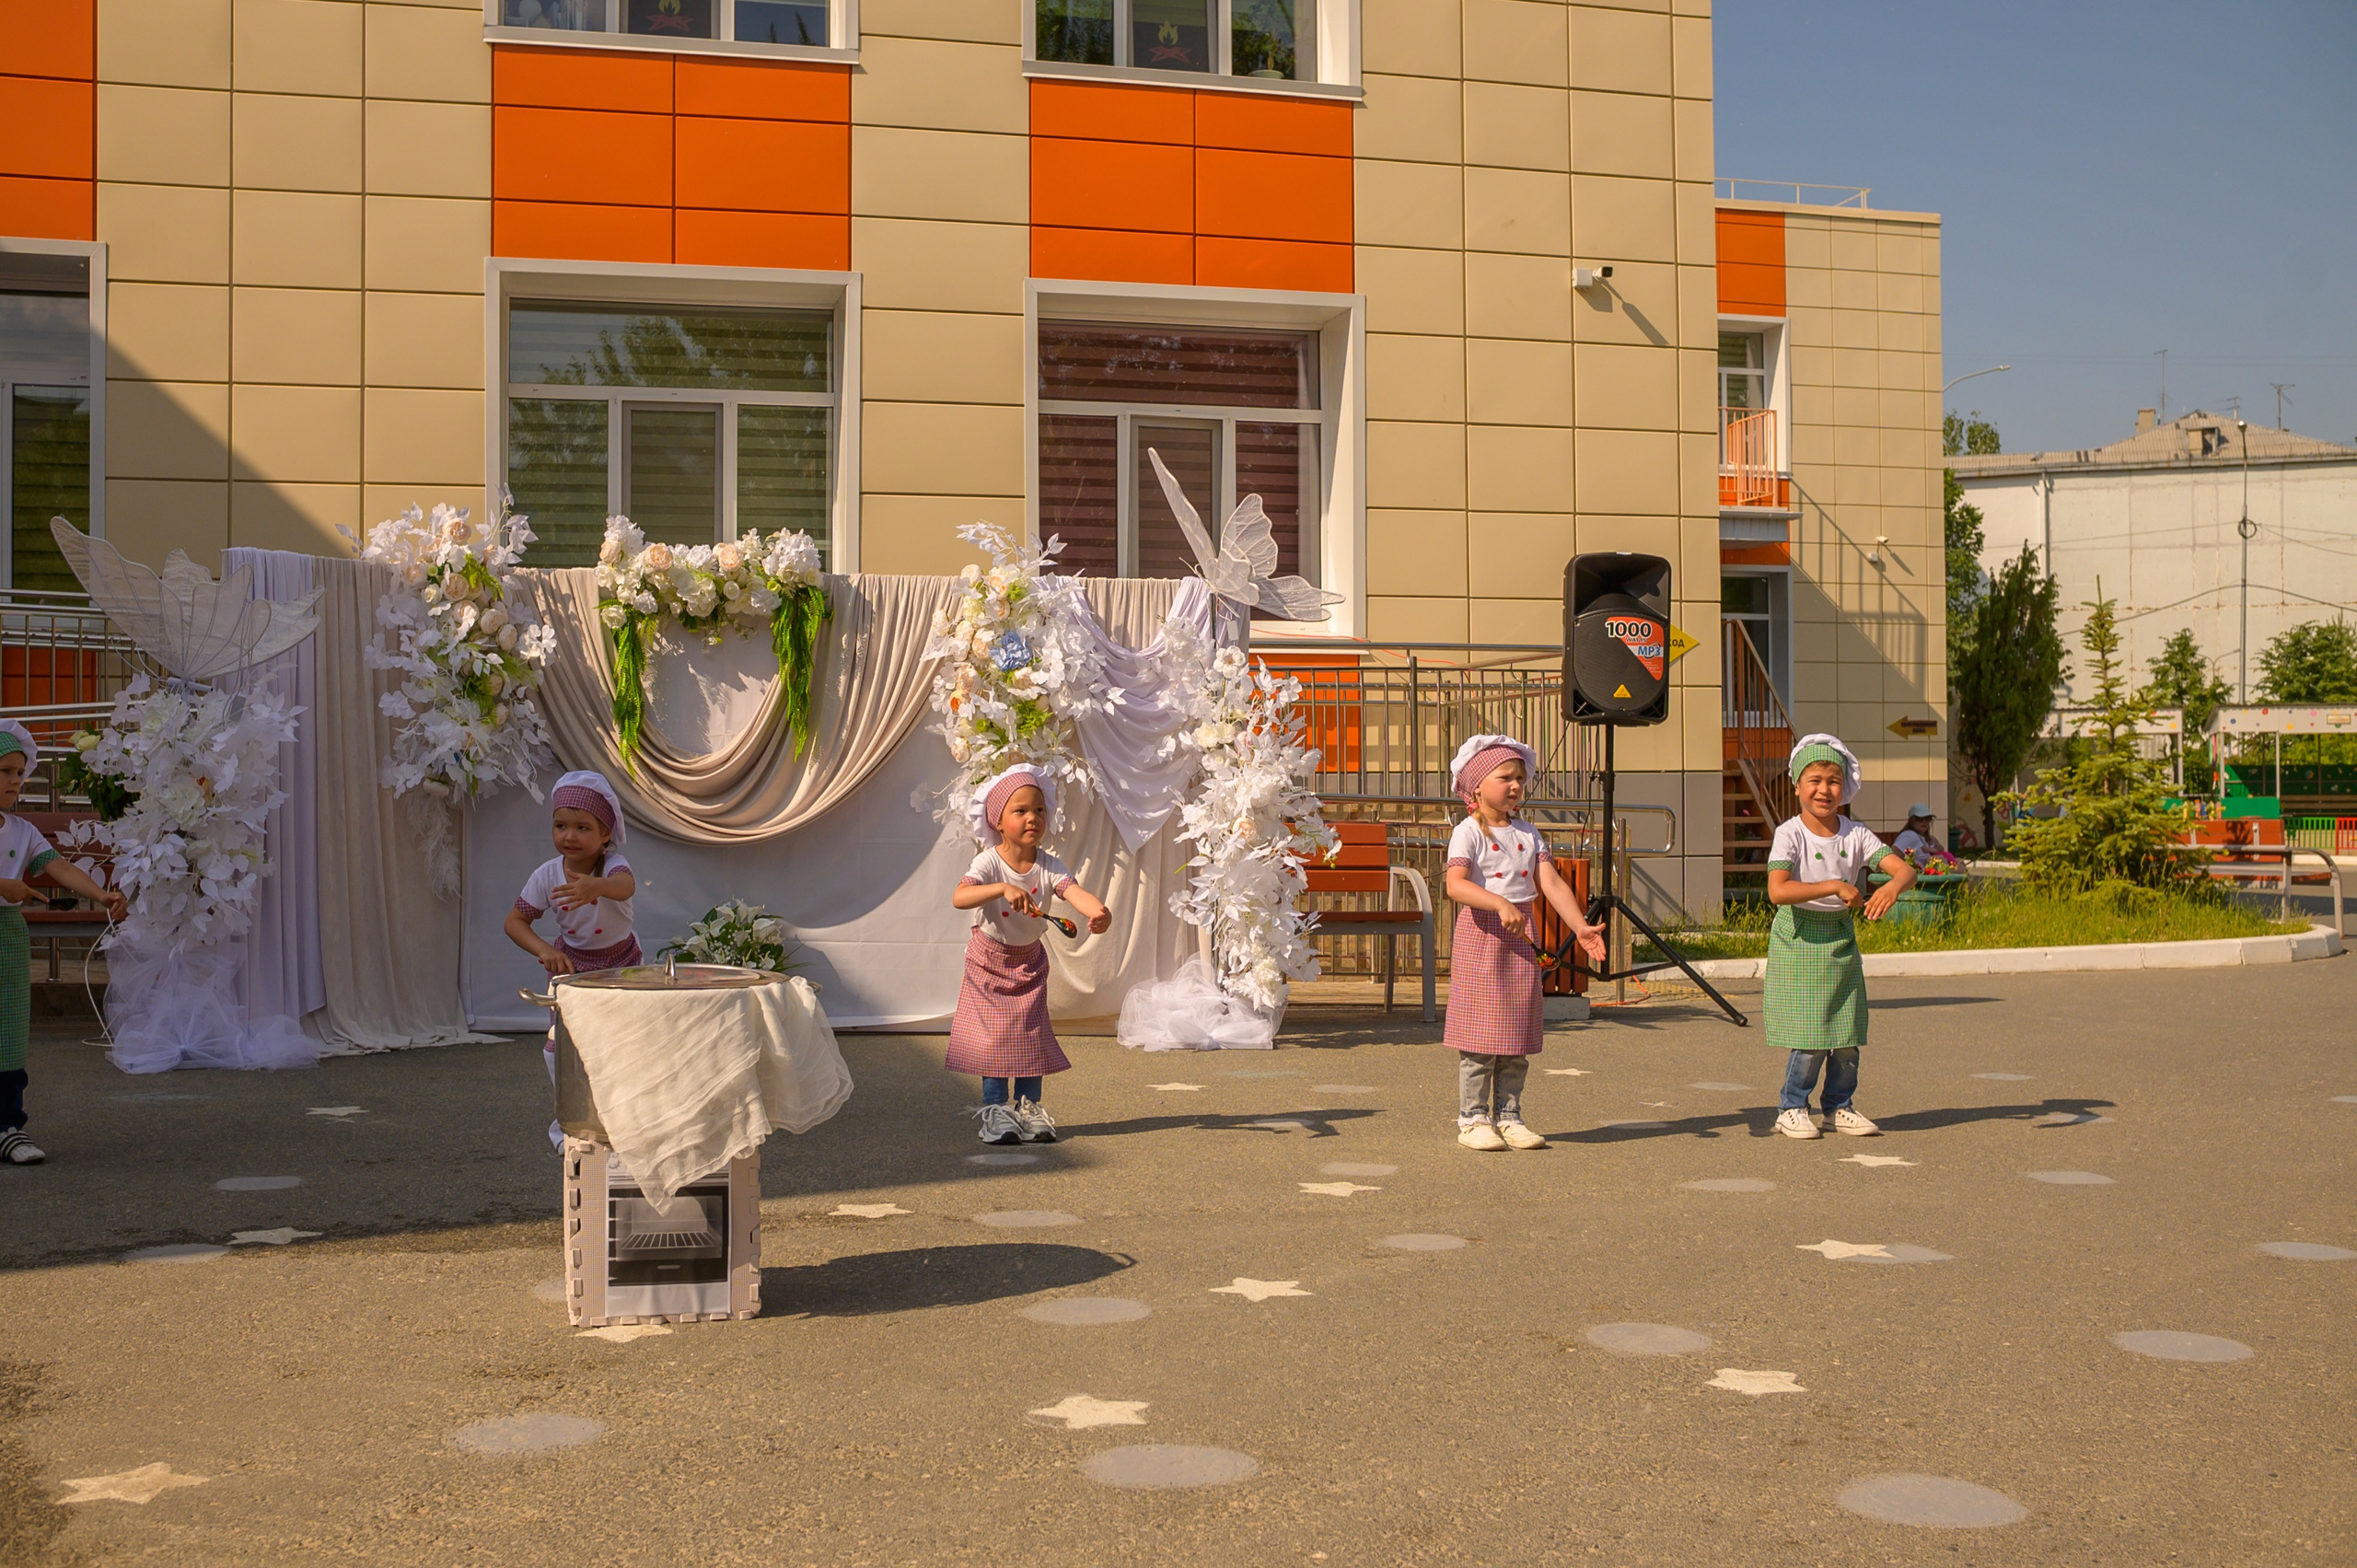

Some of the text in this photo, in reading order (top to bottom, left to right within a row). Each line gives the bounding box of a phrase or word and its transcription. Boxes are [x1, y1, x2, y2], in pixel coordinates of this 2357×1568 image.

[1605, 621, 1652, 638] 1000
[1669, 638, 1686, 648] ОД
[1637, 645, 1661, 656] MP3
